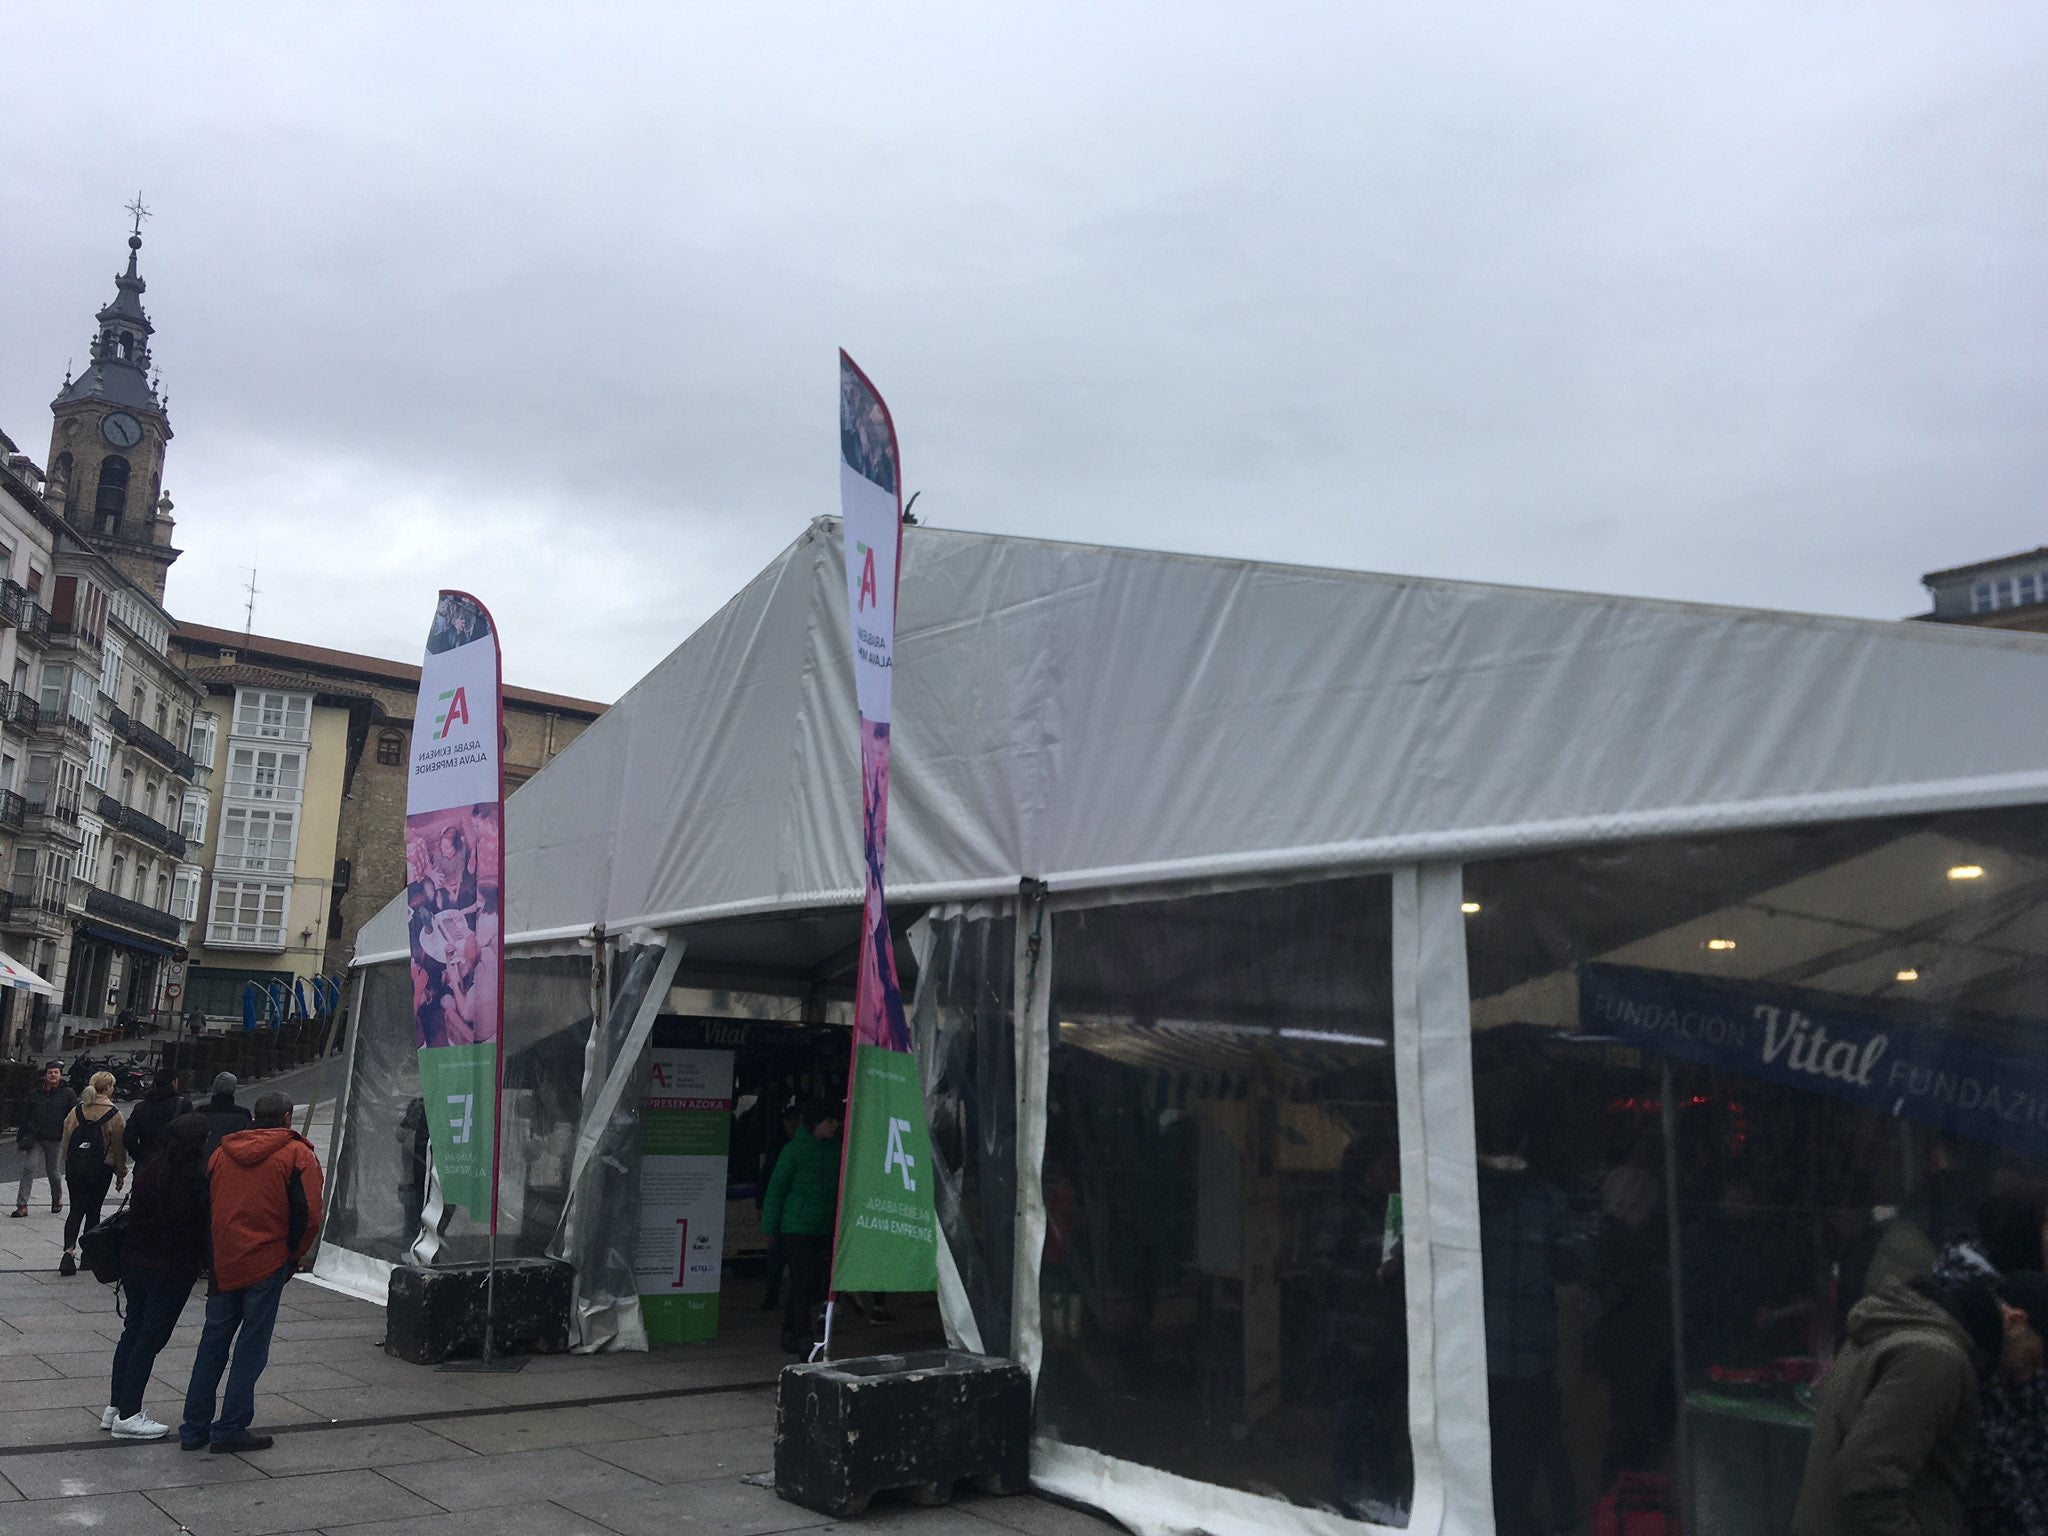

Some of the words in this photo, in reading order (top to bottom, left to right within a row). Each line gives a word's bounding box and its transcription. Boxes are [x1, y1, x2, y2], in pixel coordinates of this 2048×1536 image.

[700, 1019, 750, 1045] Vital
[1753, 1004, 1889, 1088] Vital
[688, 1100, 724, 1110] AZOKA
[855, 1214, 889, 1232] ALAVA
